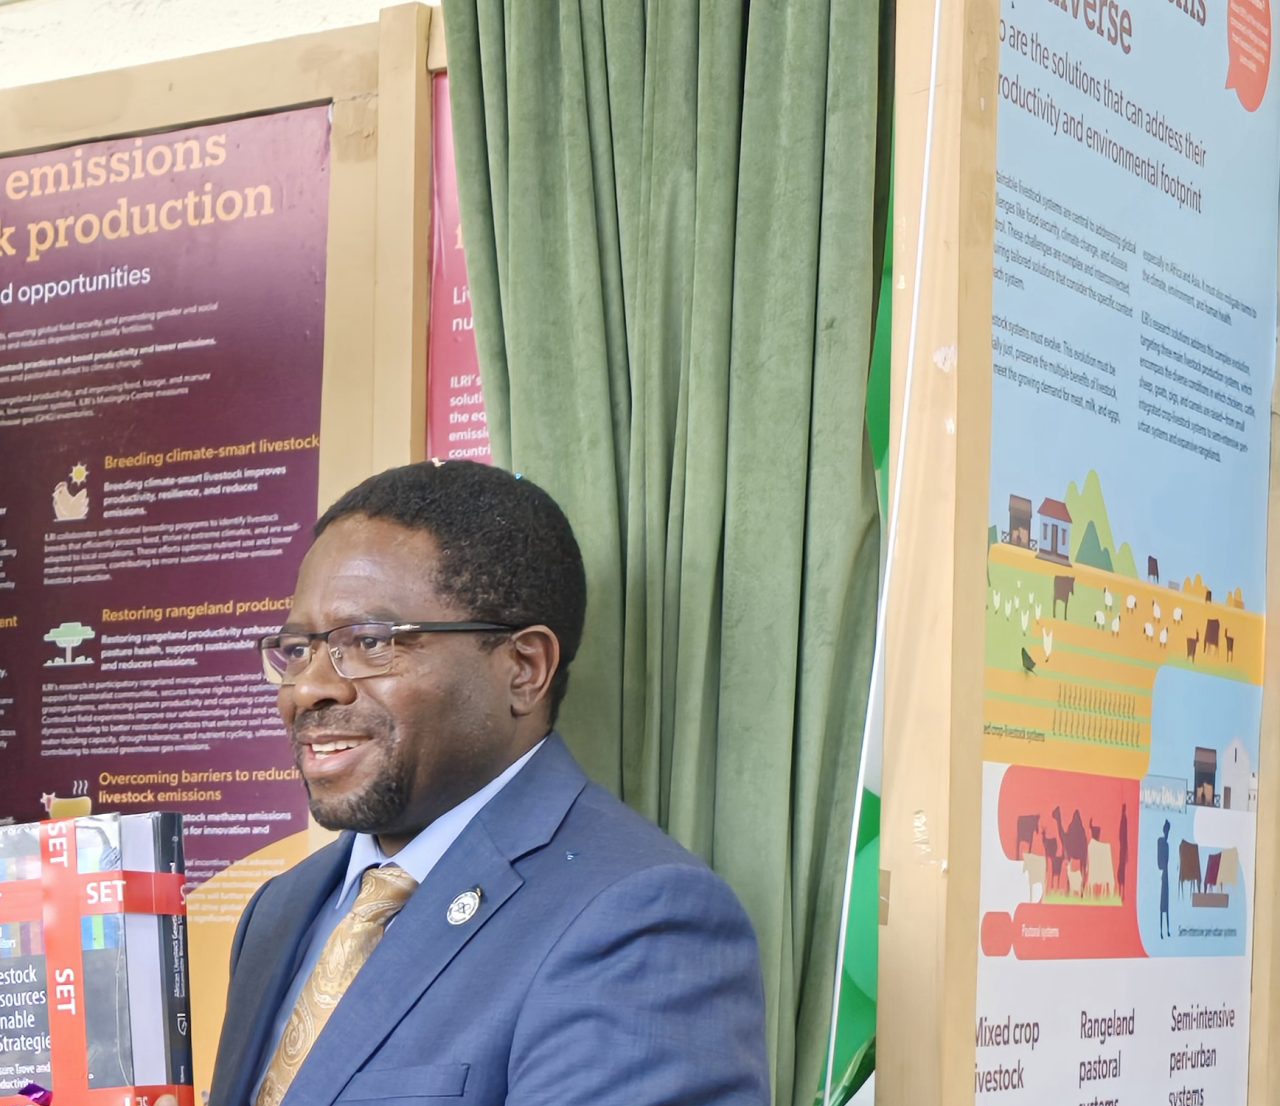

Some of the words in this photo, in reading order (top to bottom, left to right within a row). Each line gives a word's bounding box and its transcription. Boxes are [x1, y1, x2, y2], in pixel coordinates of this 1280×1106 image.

[1009, 25, 1027, 56] are
[1031, 32, 1049, 69] the
[1052, 51, 1101, 102] solutions
[1104, 79, 1123, 117] that
[1126, 100, 1143, 129] can
[1145, 110, 1183, 154] address
[1185, 132, 1206, 168] their
[998, 73, 1060, 136] roductivity
[1062, 113, 1084, 142] and
[1086, 126, 1159, 188] environmental
[1161, 162, 1202, 214] footprint
[5, 132, 227, 201] emissions
[26, 182, 274, 263] production
[17, 264, 151, 306] opportunities
[450, 392, 482, 407] soluti
[449, 411, 469, 424] the
[471, 411, 486, 423] eq
[104, 453, 164, 469] Breeding
[166, 441, 256, 463] climate-smart
[259, 434, 320, 453] livestock
[448, 443, 491, 459] countri
[103, 479, 143, 492] Breeding
[144, 473, 202, 488] climate-smart
[203, 469, 242, 482] livestock
[243, 465, 287, 479] improves
[103, 492, 156, 506] productivity,
[158, 487, 202, 501] resilience,
[203, 484, 220, 496] and
[222, 481, 258, 494] reduces
[103, 506, 147, 519] emissions.
[102, 606, 162, 622] Restoring
[166, 600, 233, 619] rangeland
[236, 596, 294, 616] producti
[101, 632, 142, 645] Restoring
[142, 629, 187, 643] rangeland
[187, 626, 242, 641] productivity
[165, 642, 203, 655] supports
[205, 639, 255, 652] sustainable
[101, 661, 117, 671] and
[118, 659, 152, 670] reduces
[153, 657, 198, 668] emissions.
[99, 770, 179, 787] Overcoming
[181, 769, 233, 783] barriers
[235, 769, 248, 782] to
[98, 790, 156, 804] livestock
[157, 788, 222, 802] emissions
[183, 812, 206, 823] stock
[207, 812, 247, 823] methane
[247, 810, 292, 822] emissions
[190, 825, 203, 836] for
[203, 824, 251, 835] innovation
[252, 824, 270, 834] and
[47, 820, 69, 868] SET
[86, 879, 127, 905] SET
[55, 968, 76, 1015] SET
[1080, 1008, 1135, 1045] Rangeland
[1170, 1003, 1235, 1033] Semi-intensive
[1013, 1020, 1040, 1050] crop
[15, 1063, 35, 1075] Trove
[35, 1061, 51, 1073] and
[1078, 1050, 1121, 1088] pastoral
[1169, 1043, 1217, 1078] peri-urban
[975, 1059, 1024, 1093] ivestock
